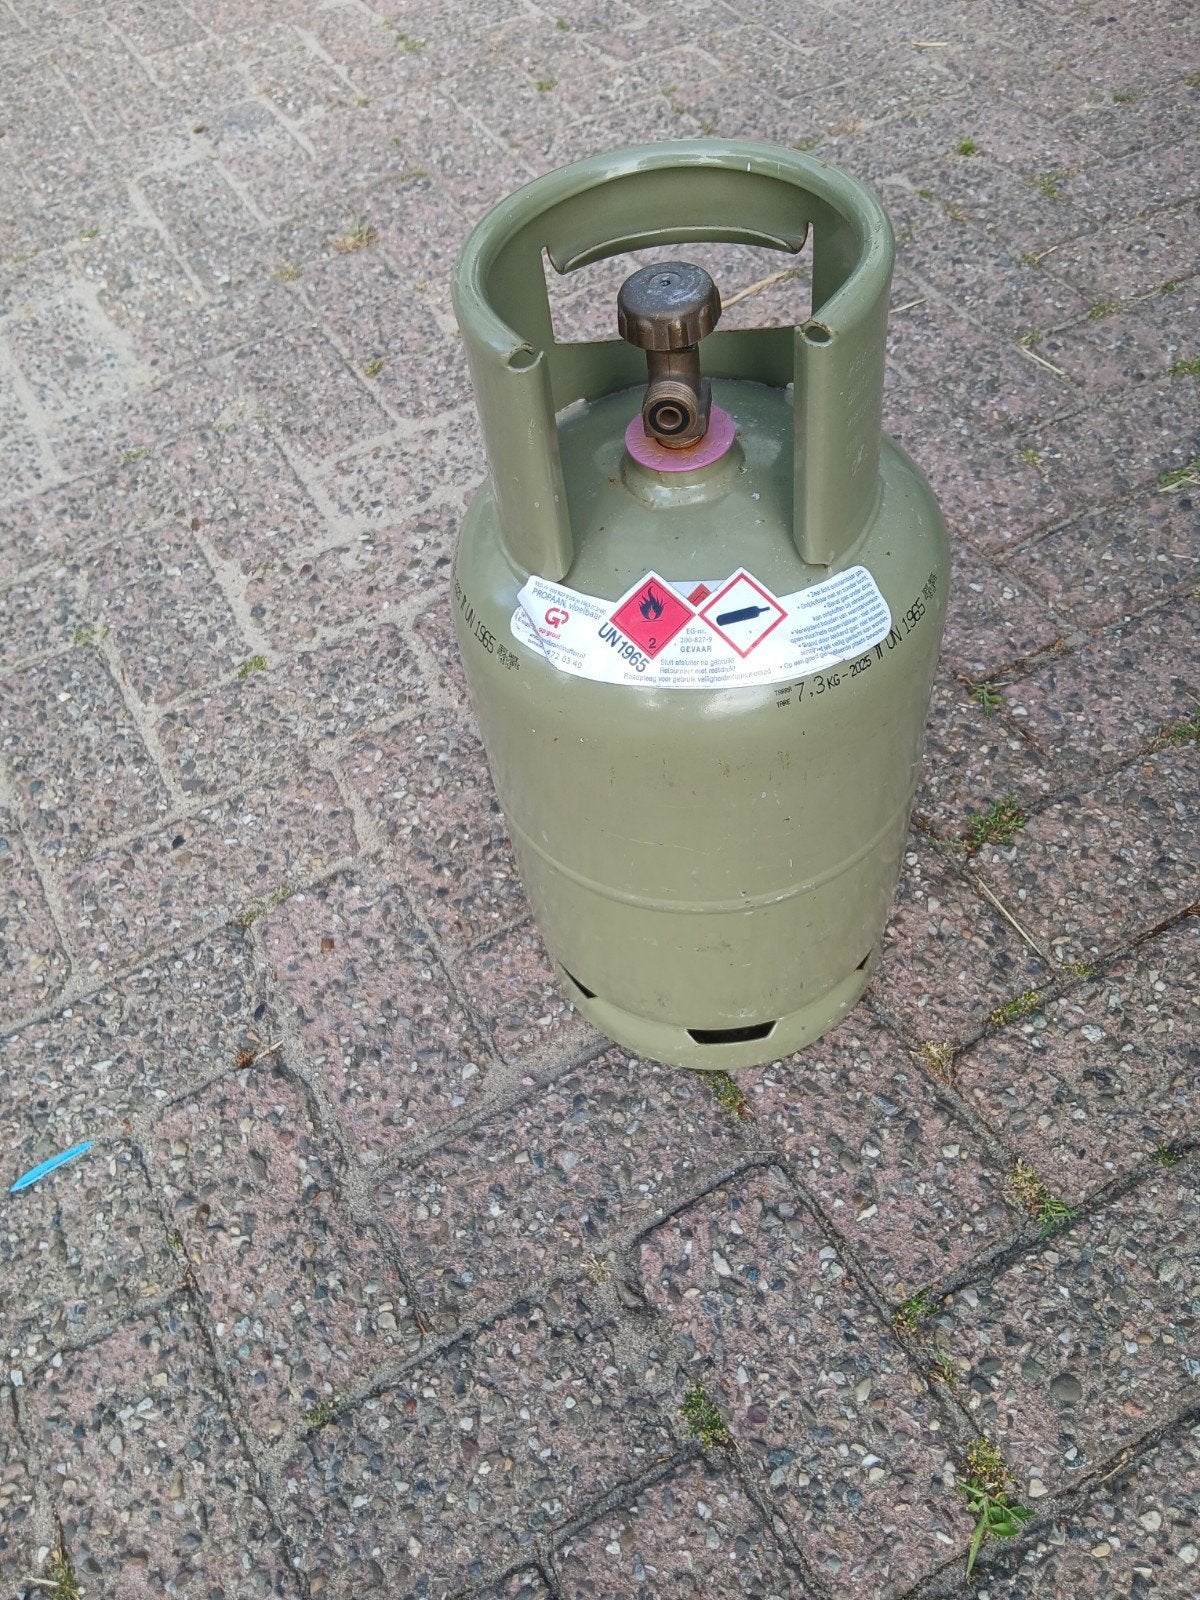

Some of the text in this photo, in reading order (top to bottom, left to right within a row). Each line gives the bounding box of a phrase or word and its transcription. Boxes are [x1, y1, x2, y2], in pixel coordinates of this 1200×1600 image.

[648, 637, 657, 649] 2
[827, 674, 841, 688] KG
[885, 625, 903, 651] UN
[901, 596, 926, 635] 1965
